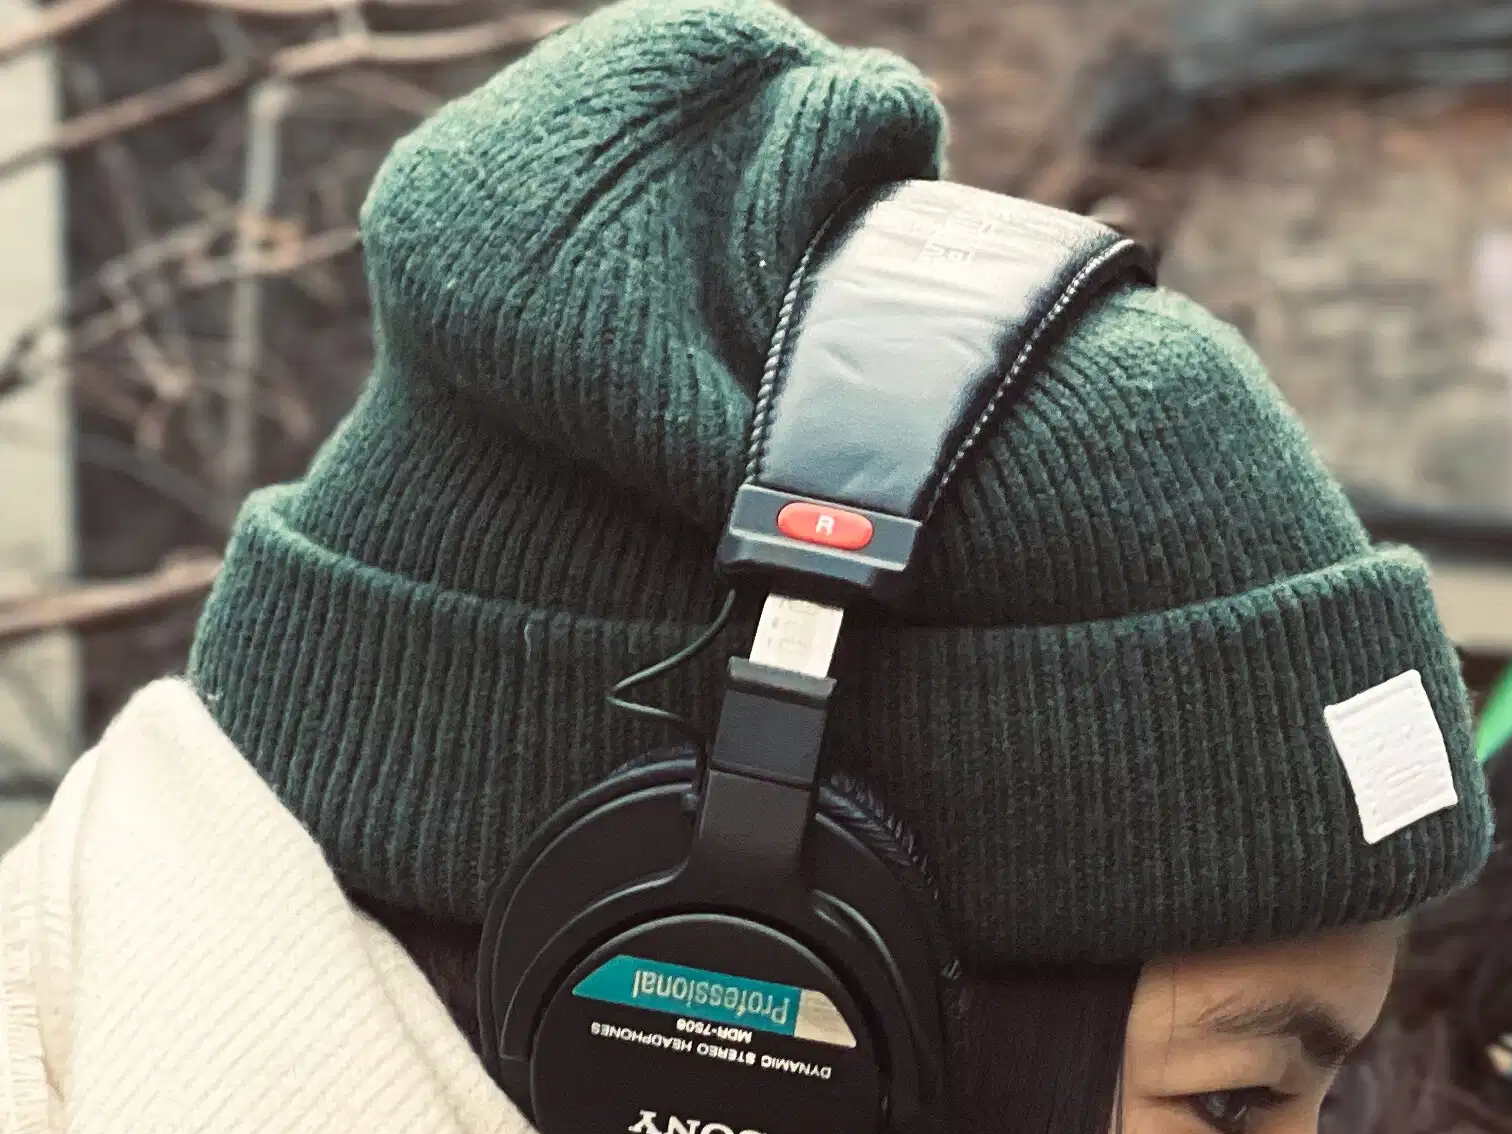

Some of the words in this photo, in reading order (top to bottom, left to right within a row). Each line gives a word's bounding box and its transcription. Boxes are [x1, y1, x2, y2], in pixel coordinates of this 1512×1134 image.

[815, 514, 835, 536] R
[632, 969, 791, 1026] Professional
[591, 1021, 692, 1051] HEADPHONES
[697, 1042, 755, 1065] STEREO
[761, 1054, 832, 1080] DYNAMIC
